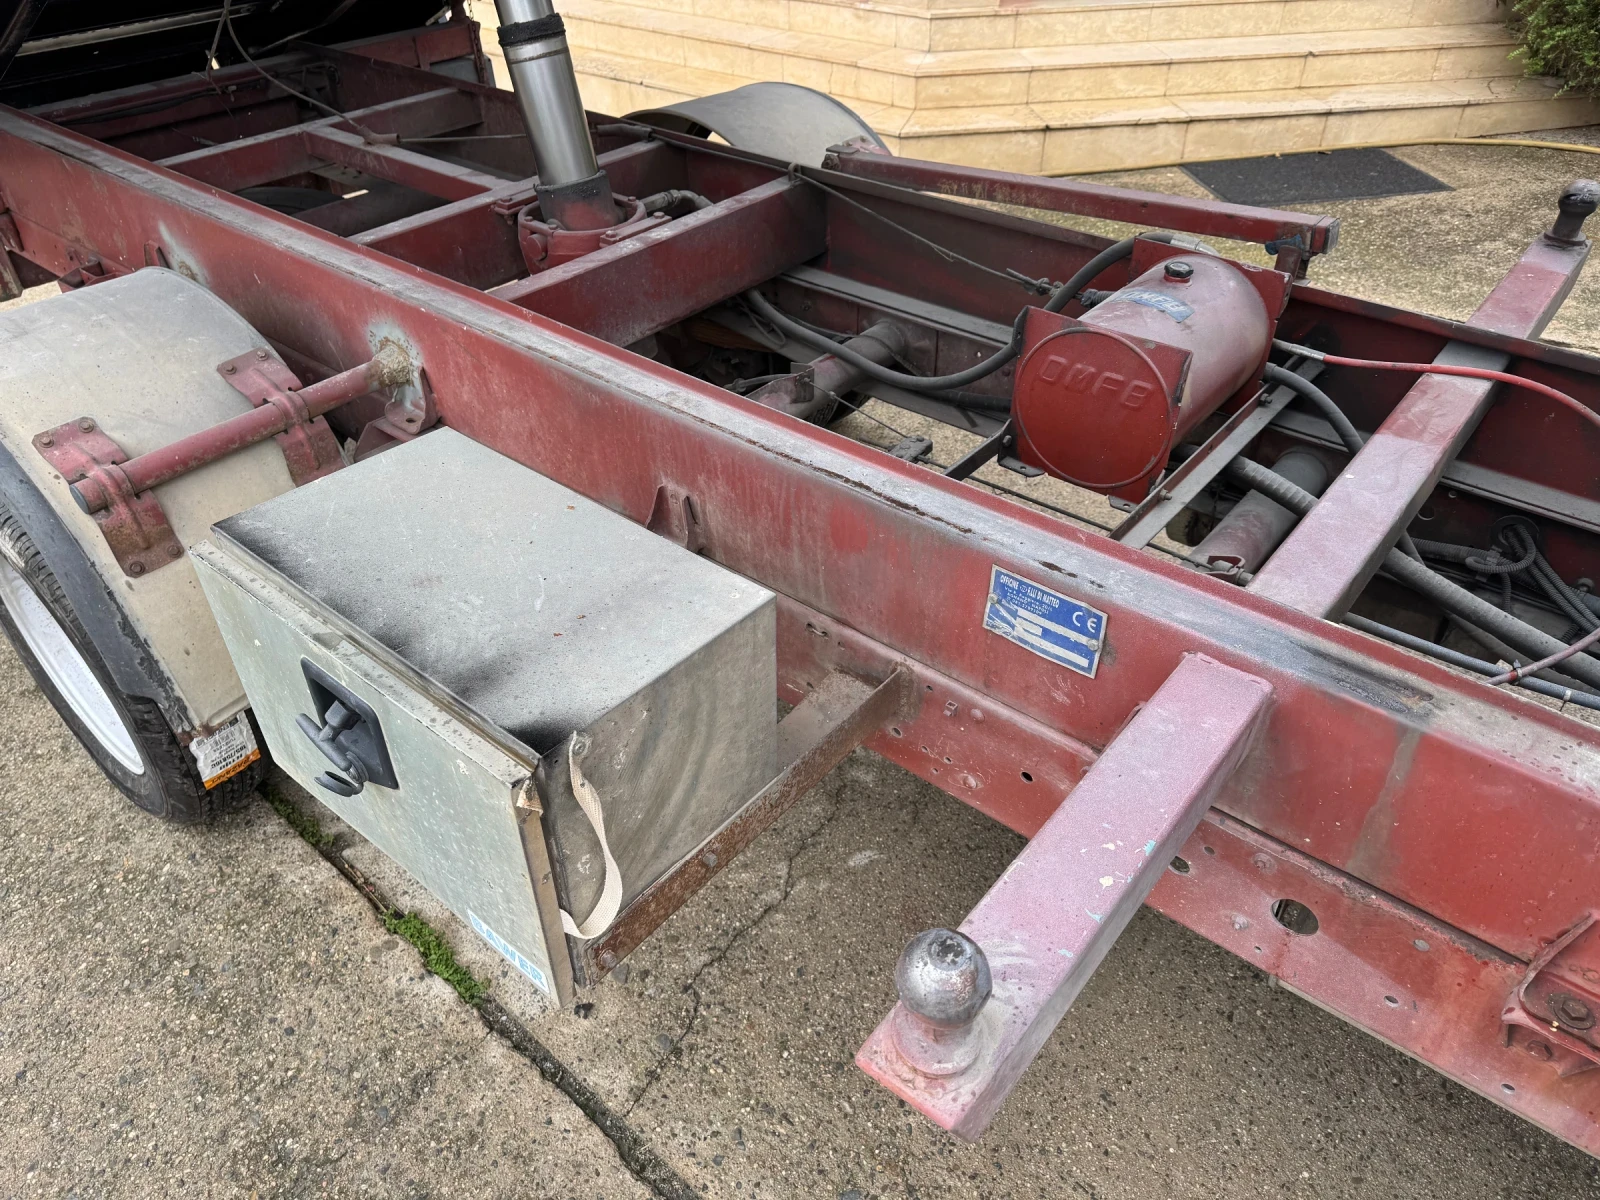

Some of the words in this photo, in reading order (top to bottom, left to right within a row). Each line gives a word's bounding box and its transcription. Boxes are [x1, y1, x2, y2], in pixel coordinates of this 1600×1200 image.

[1038, 354, 1155, 411] OMFB
[1000, 575, 1018, 589] OFFICINE
[1042, 594, 1059, 608] MATTEO
[1072, 611, 1097, 633] CE
[470, 913, 546, 989] BAWER
